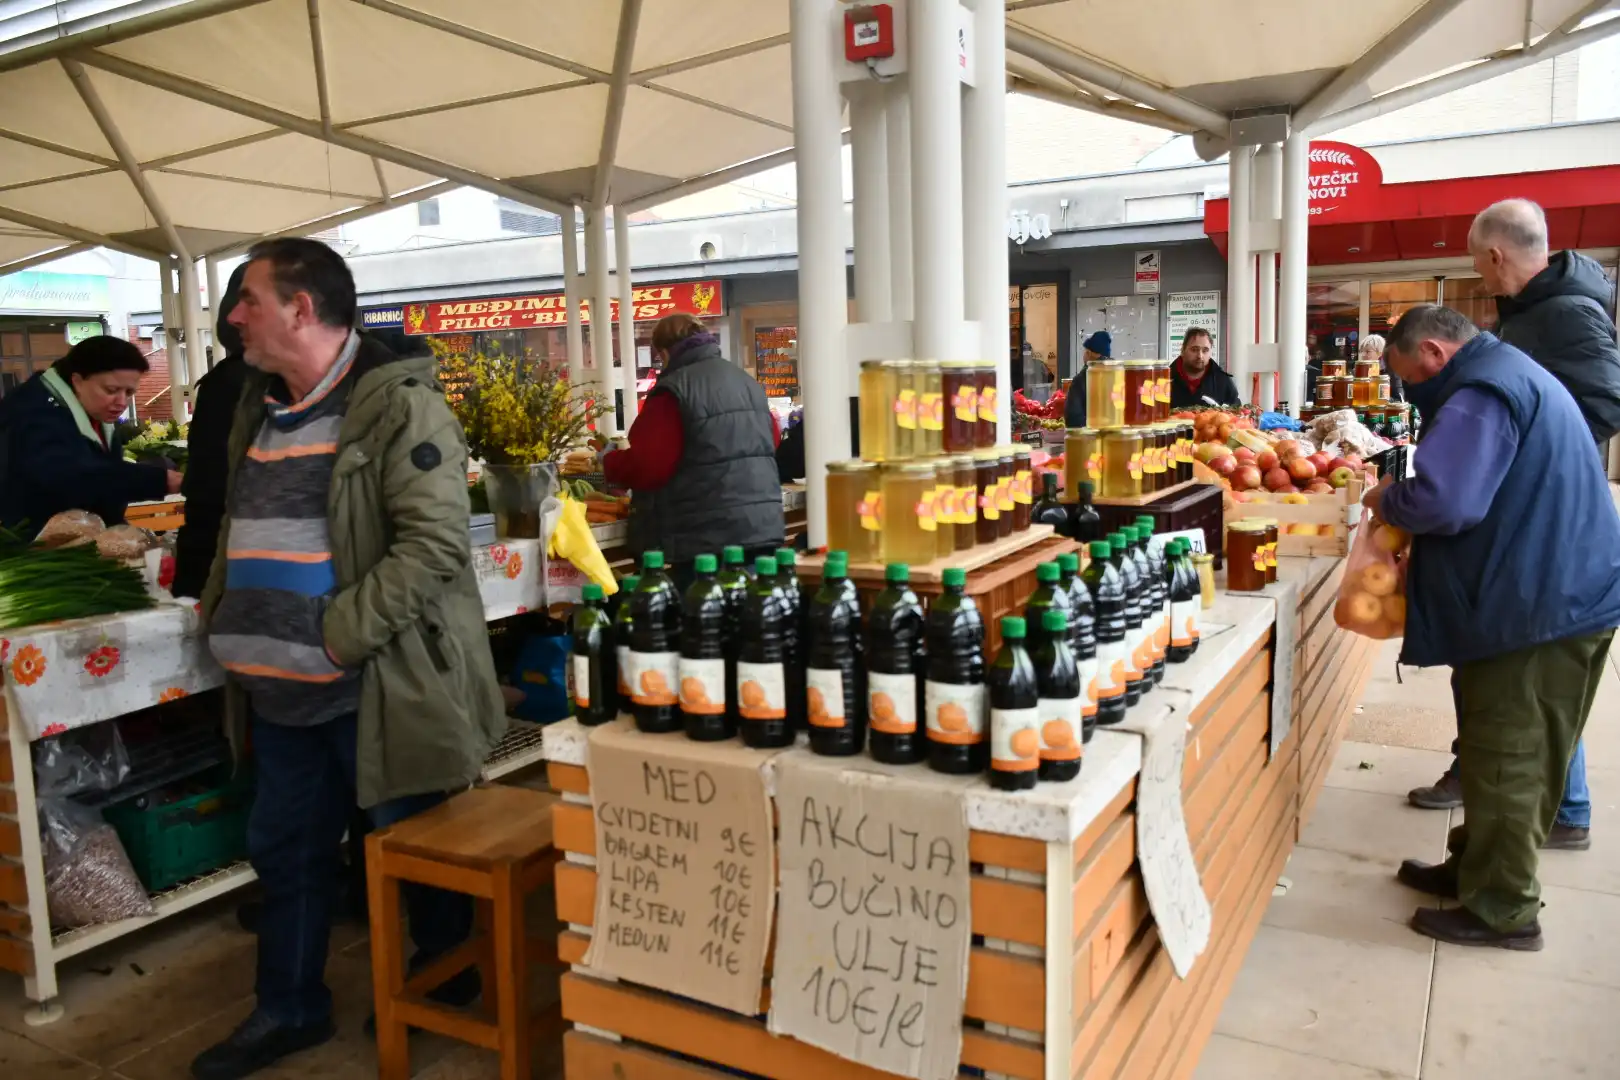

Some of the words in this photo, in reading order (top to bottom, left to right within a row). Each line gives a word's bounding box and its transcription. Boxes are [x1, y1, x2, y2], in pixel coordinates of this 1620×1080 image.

[1307, 171, 1359, 187] VEČKI
[1307, 187, 1347, 200] NOVI
[1307, 207, 1323, 215] 93
[438, 312, 513, 331] PILIĆI
[642, 761, 717, 805] MED
[597, 801, 700, 844] CVIJETNI
[720, 827, 756, 857] 9€
[800, 796, 957, 877] AKCIJA
[611, 861, 660, 894] LIPA
[709, 884, 753, 919] 10€
[712, 860, 753, 890] 10€
[808, 858, 958, 930] BUČINO
[609, 887, 687, 928] KESTEN
[707, 912, 746, 945] 11€
[607, 922, 672, 954] MEDUN
[699, 940, 741, 976] 11€
[833, 920, 939, 988] ULJE
